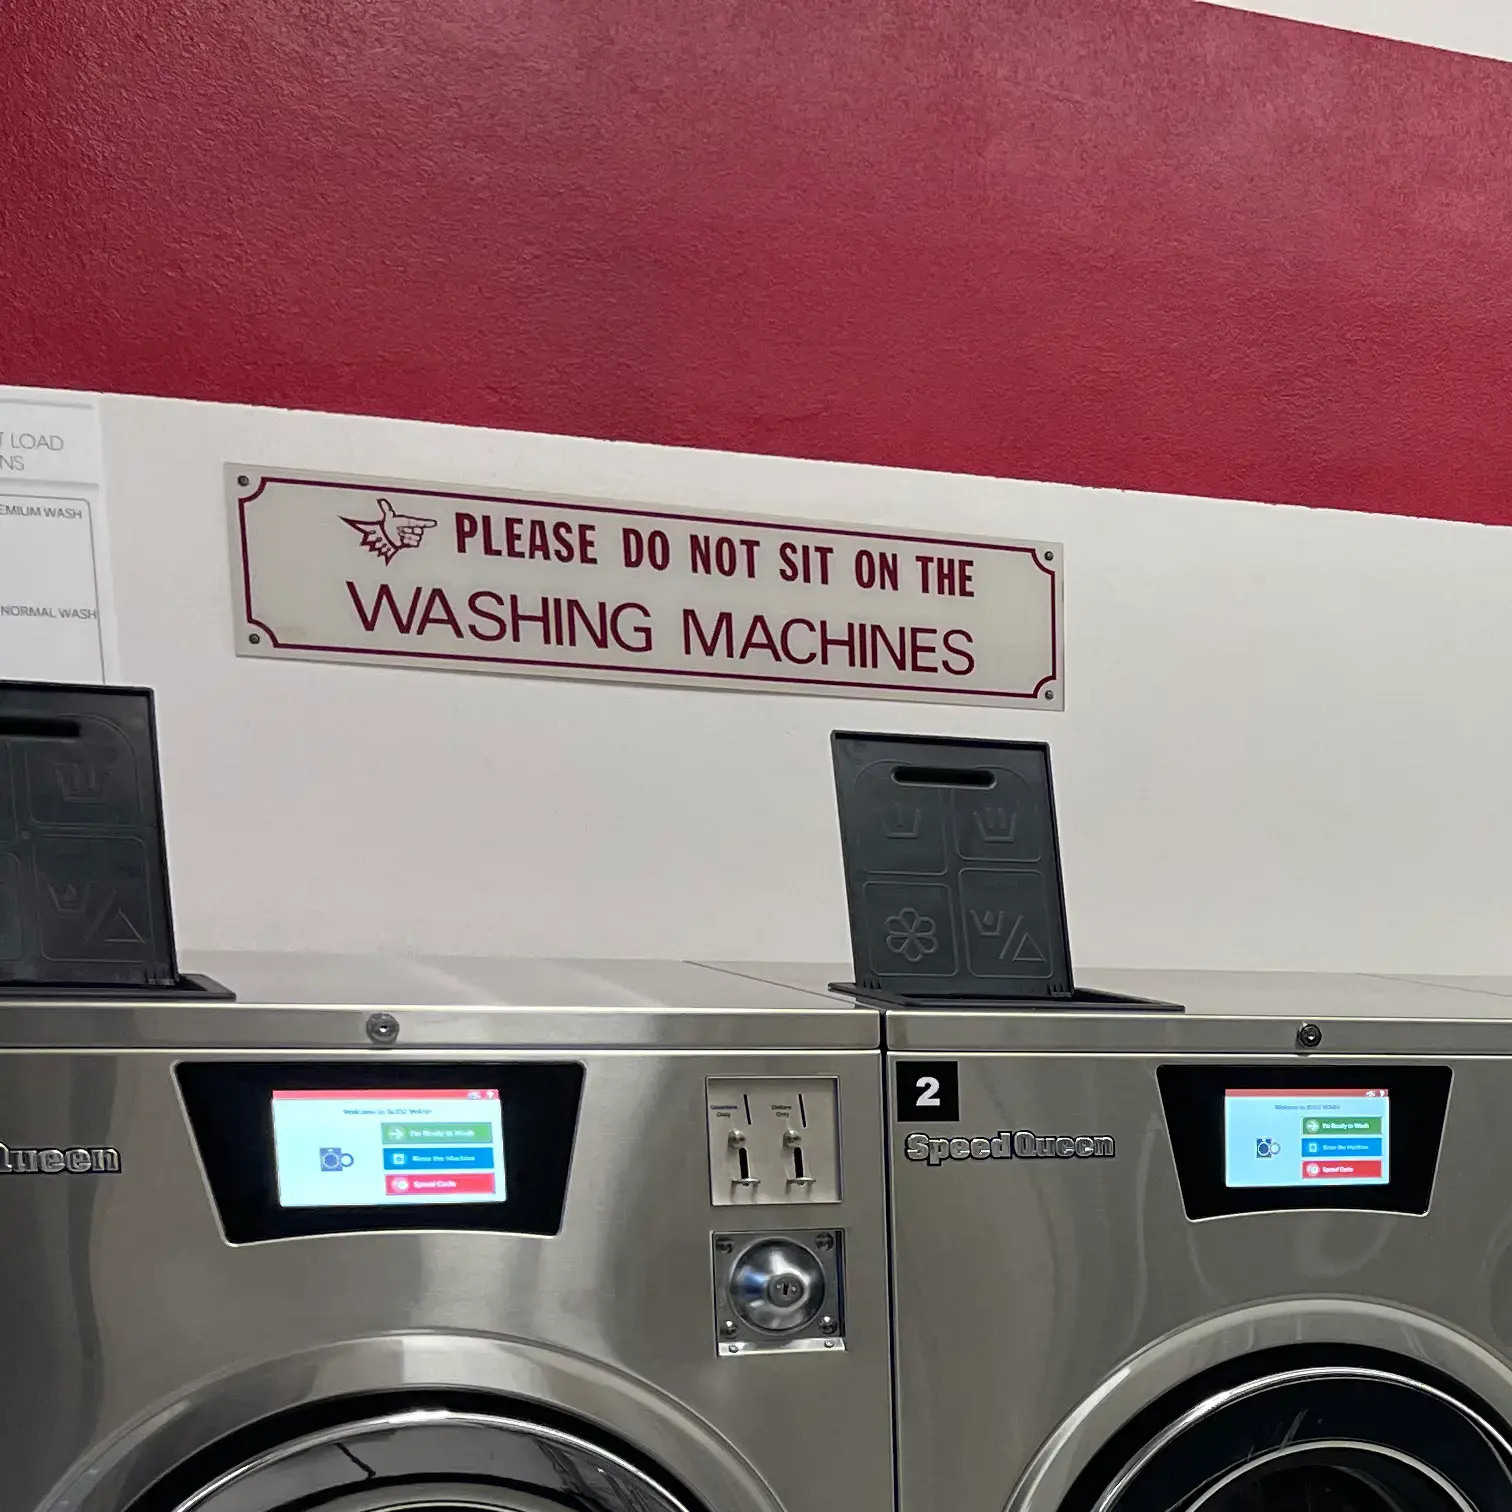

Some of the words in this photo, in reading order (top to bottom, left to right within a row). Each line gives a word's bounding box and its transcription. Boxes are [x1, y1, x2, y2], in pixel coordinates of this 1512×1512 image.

[11, 432, 64, 451] LOAD
[43, 507, 82, 519] WASH
[455, 512, 599, 567] PLEASE
[622, 527, 669, 570] DO
[691, 535, 761, 579] NOT
[779, 543, 833, 585] SIT
[855, 550, 899, 590] ON
[915, 556, 975, 597] THE
[1, 605, 57, 618] NORMAL
[58, 607, 98, 619] WASH
[346, 581, 653, 653] WASHING
[683, 609, 975, 677] MACHINES
[915, 1076, 941, 1106] 2
[905, 1131, 1012, 1166] Speed
[1013, 1130, 1115, 1157] Queen
